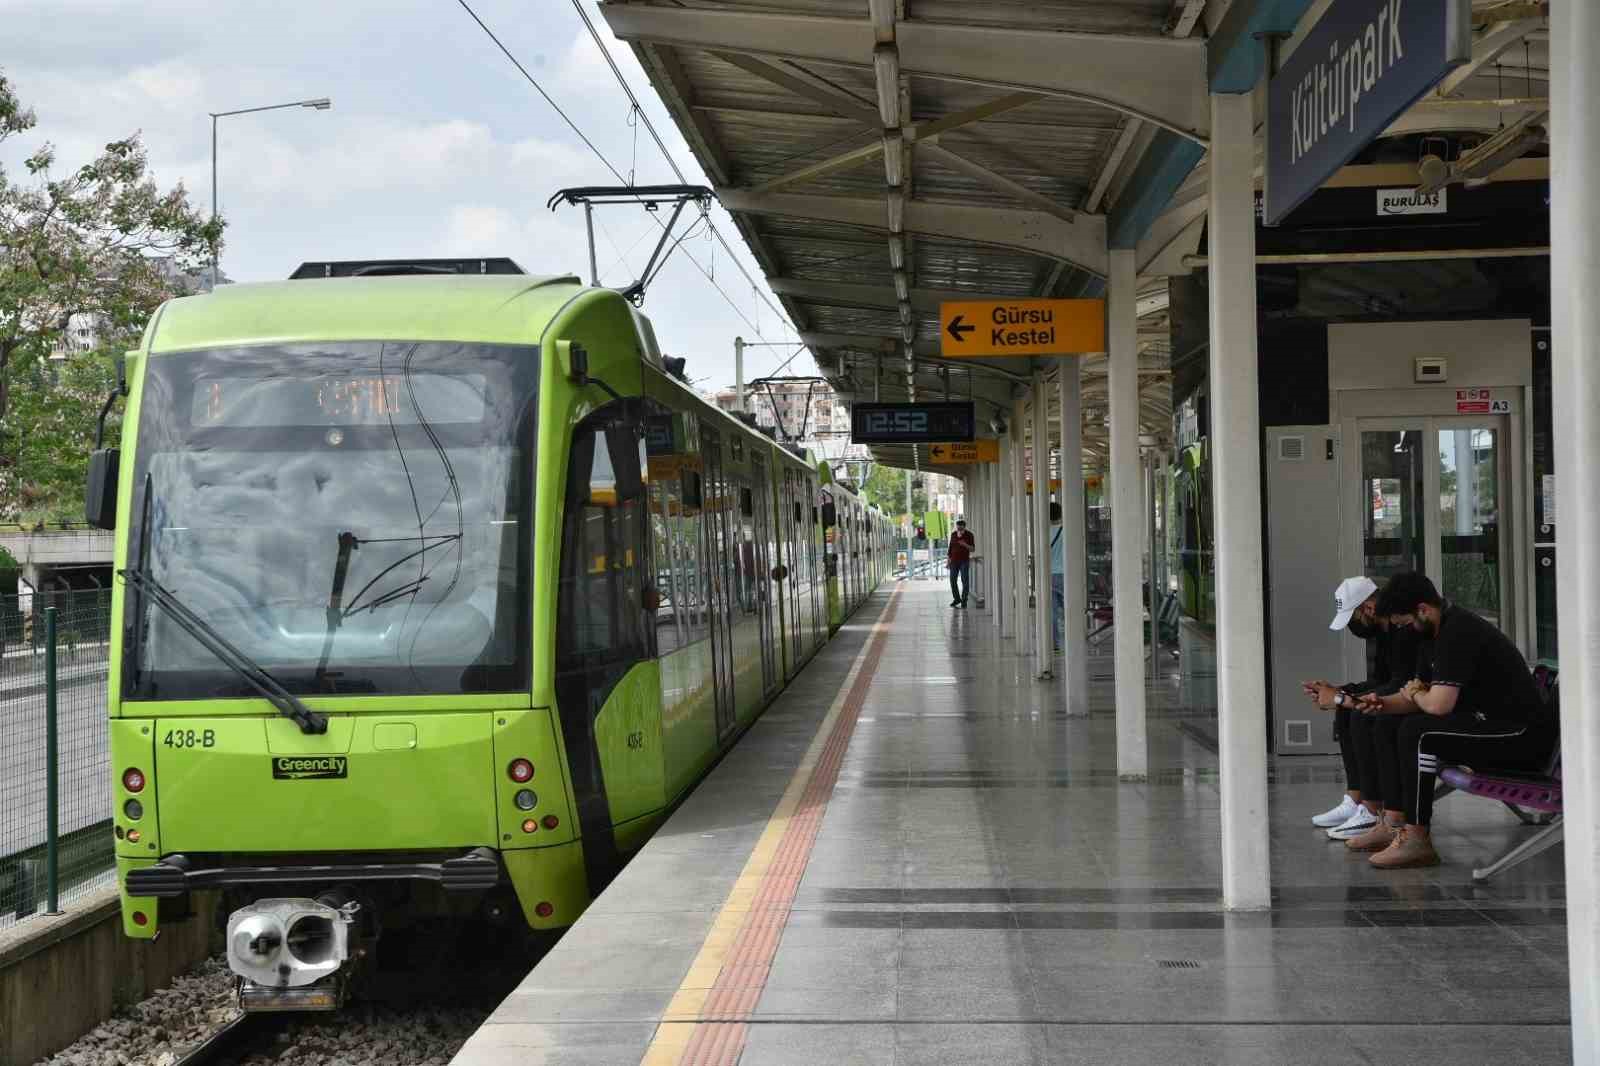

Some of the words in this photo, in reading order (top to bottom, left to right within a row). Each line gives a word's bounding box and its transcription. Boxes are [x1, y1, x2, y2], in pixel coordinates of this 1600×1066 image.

[1292, 0, 1403, 165] Kültürpark
[992, 305, 1053, 325] Gürsu
[992, 327, 1055, 346] Kestel
[1492, 400, 1509, 411] A3
[865, 411, 928, 433] 12:52
[164, 729, 215, 748] 438-B
[278, 758, 345, 774] Greencity
